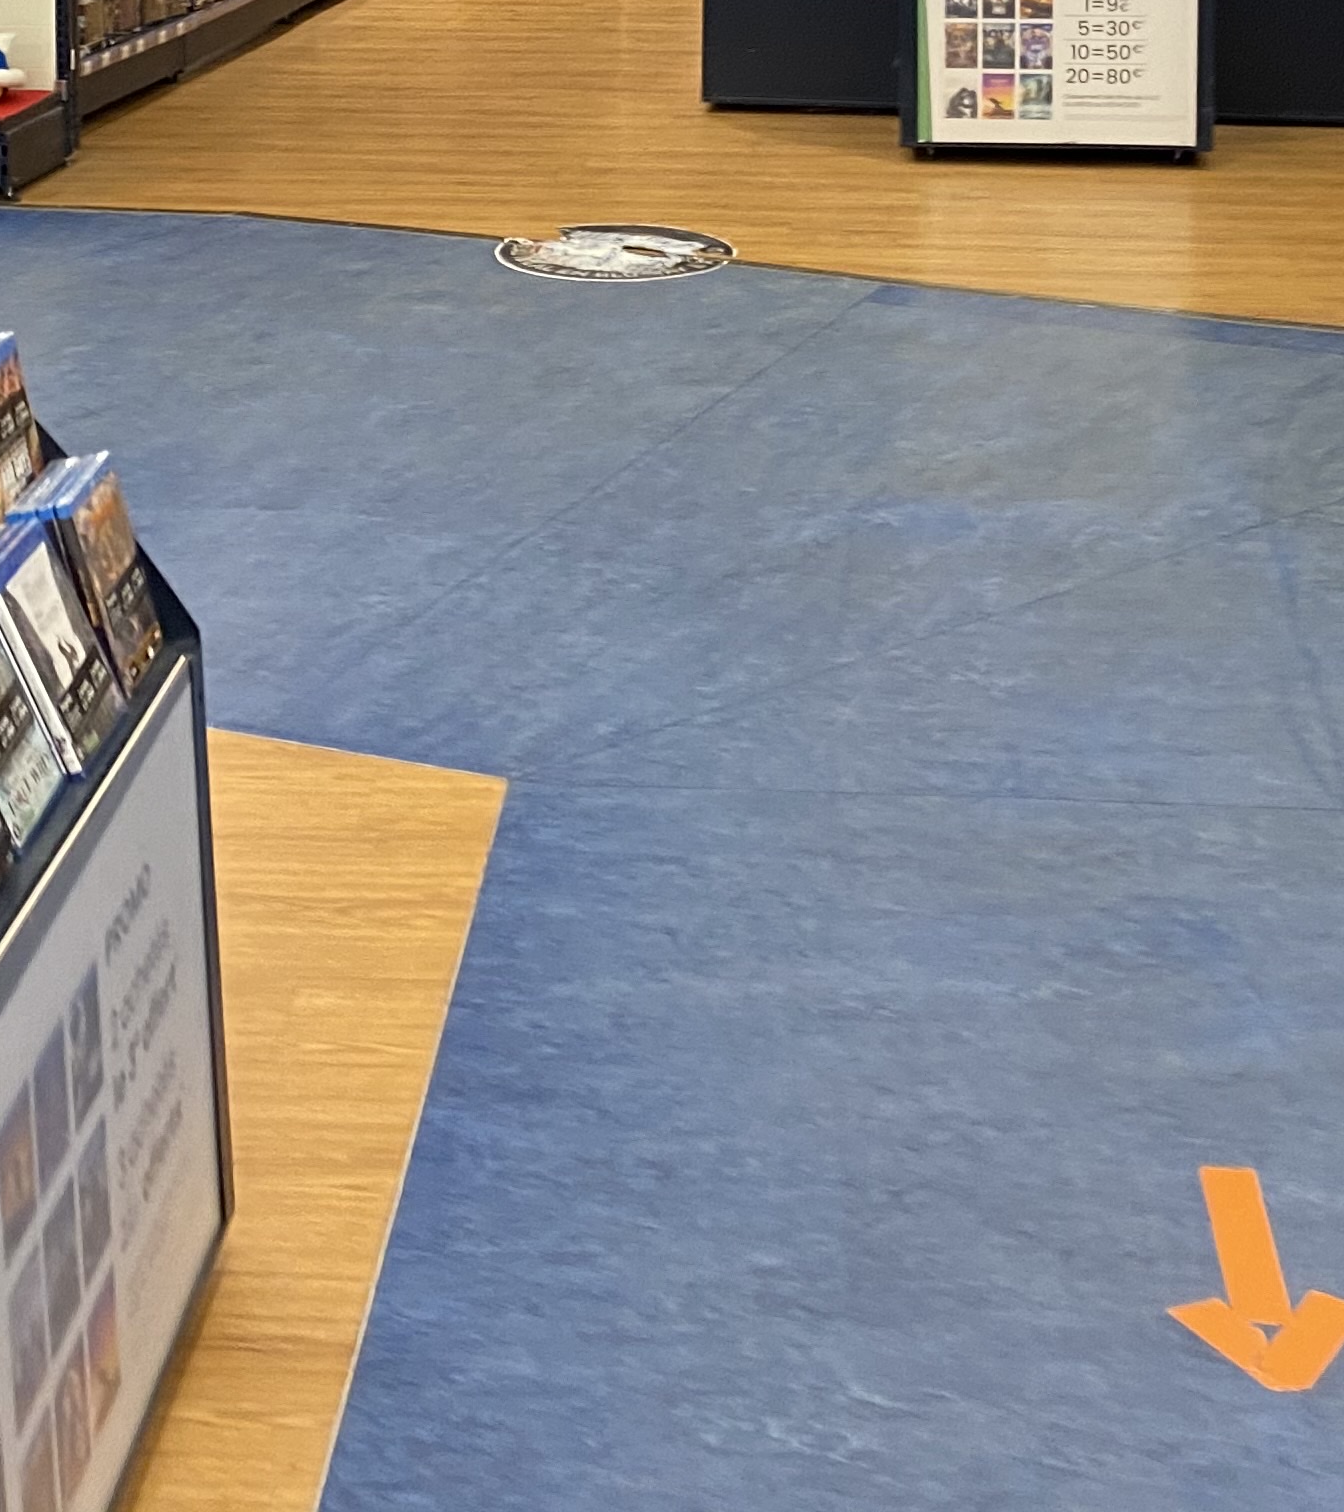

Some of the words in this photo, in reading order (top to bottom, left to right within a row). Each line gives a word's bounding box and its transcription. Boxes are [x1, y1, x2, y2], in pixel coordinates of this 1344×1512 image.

[1078, 20, 1145, 36] 5=30€
[1071, 44, 1147, 60] 10=50€
[1065, 68, 1147, 84] 20=80€
